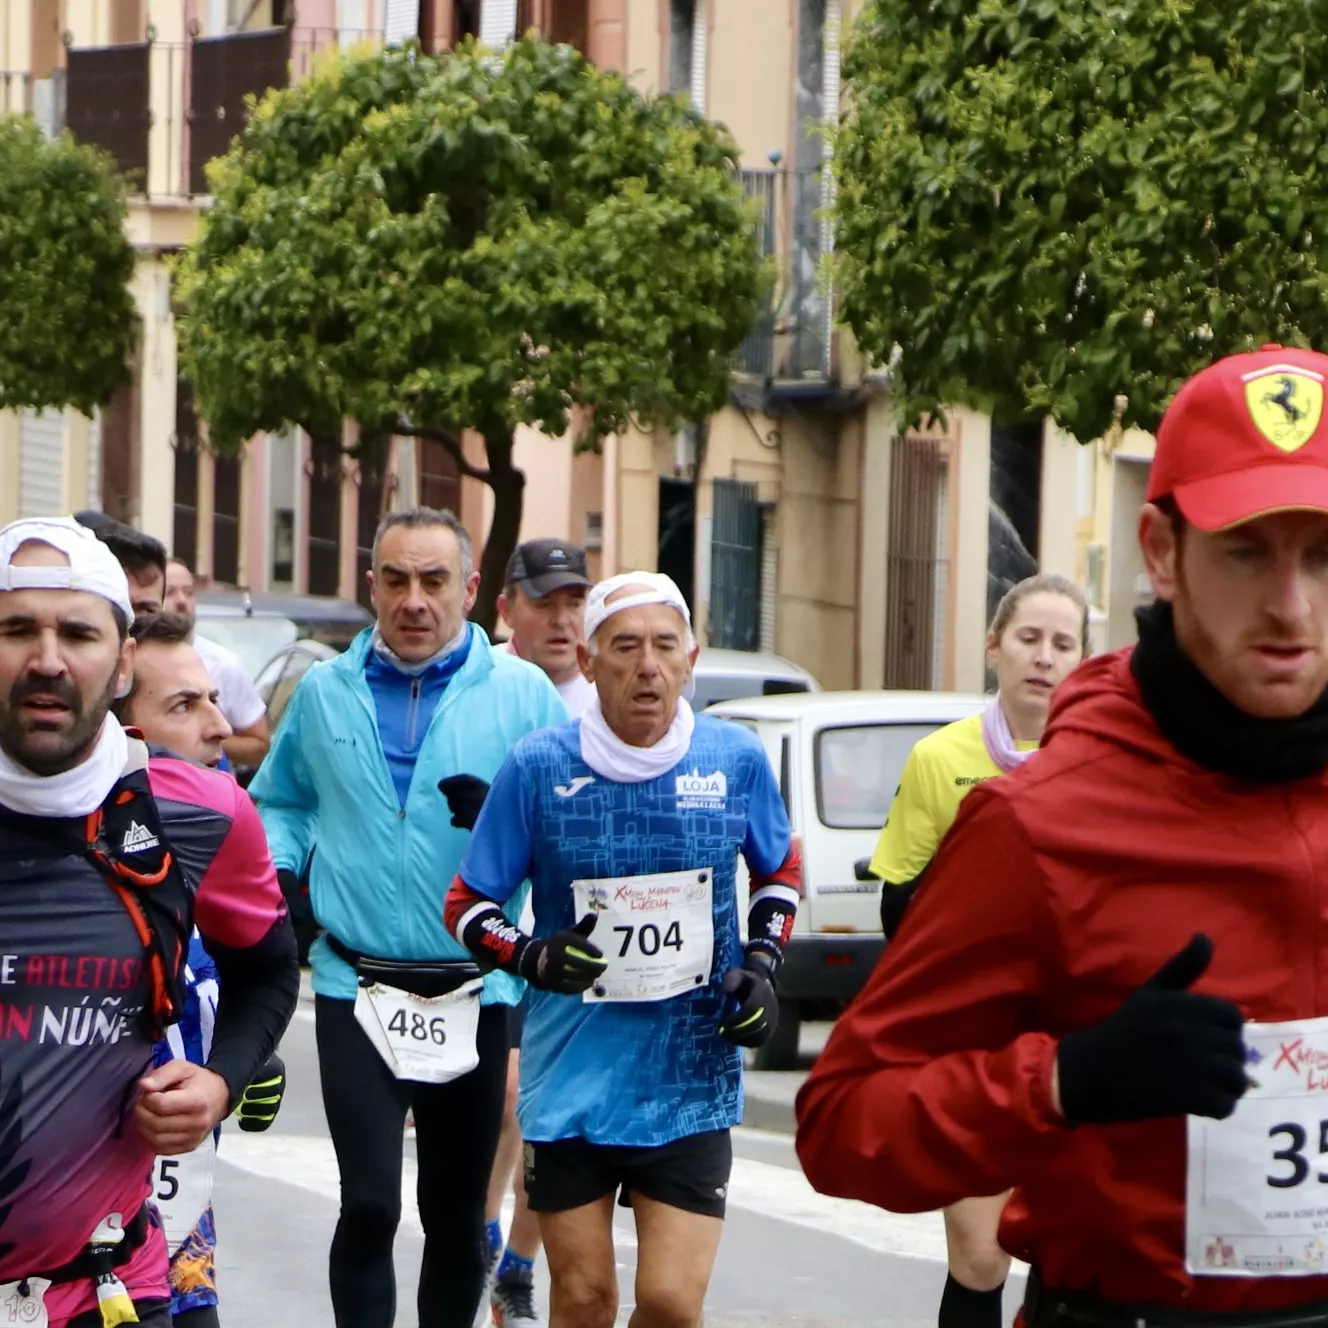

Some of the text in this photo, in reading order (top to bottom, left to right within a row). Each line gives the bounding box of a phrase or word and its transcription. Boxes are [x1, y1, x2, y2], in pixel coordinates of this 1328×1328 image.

[683, 780, 720, 792] LOJA
[613, 920, 684, 957] 704
[26, 954, 144, 991] ATLETIS
[387, 1008, 446, 1046] 486
